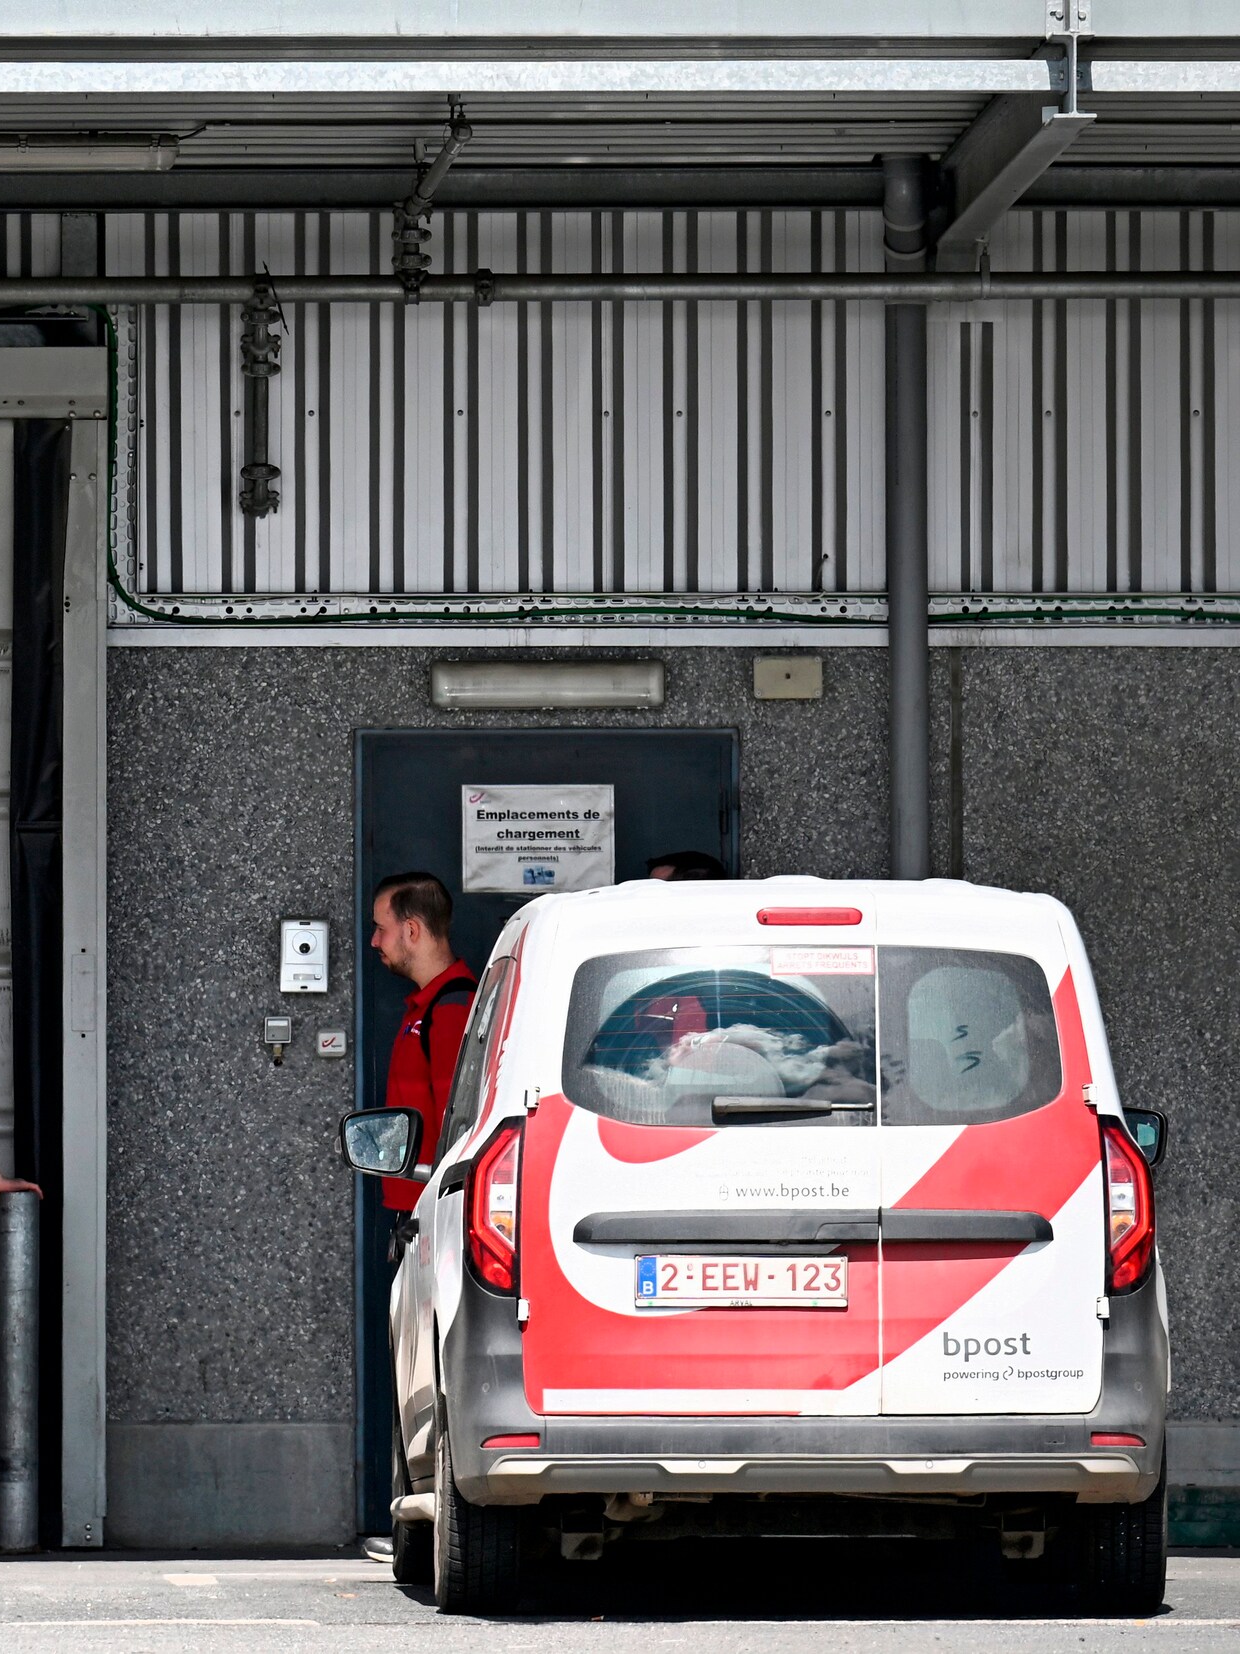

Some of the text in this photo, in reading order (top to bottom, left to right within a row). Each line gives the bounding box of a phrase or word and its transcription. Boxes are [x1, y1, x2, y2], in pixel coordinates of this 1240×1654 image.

[476, 809, 601, 822] Emplacements de
[496, 828, 581, 841] chargement
[475, 845, 504, 853] (Interdit
[735, 1182, 850, 1201] www.bpost.be
[642, 1281, 654, 1295] B
[942, 1331, 1032, 1363] bpost
[943, 1368, 1084, 1381] powering bpostgroup
